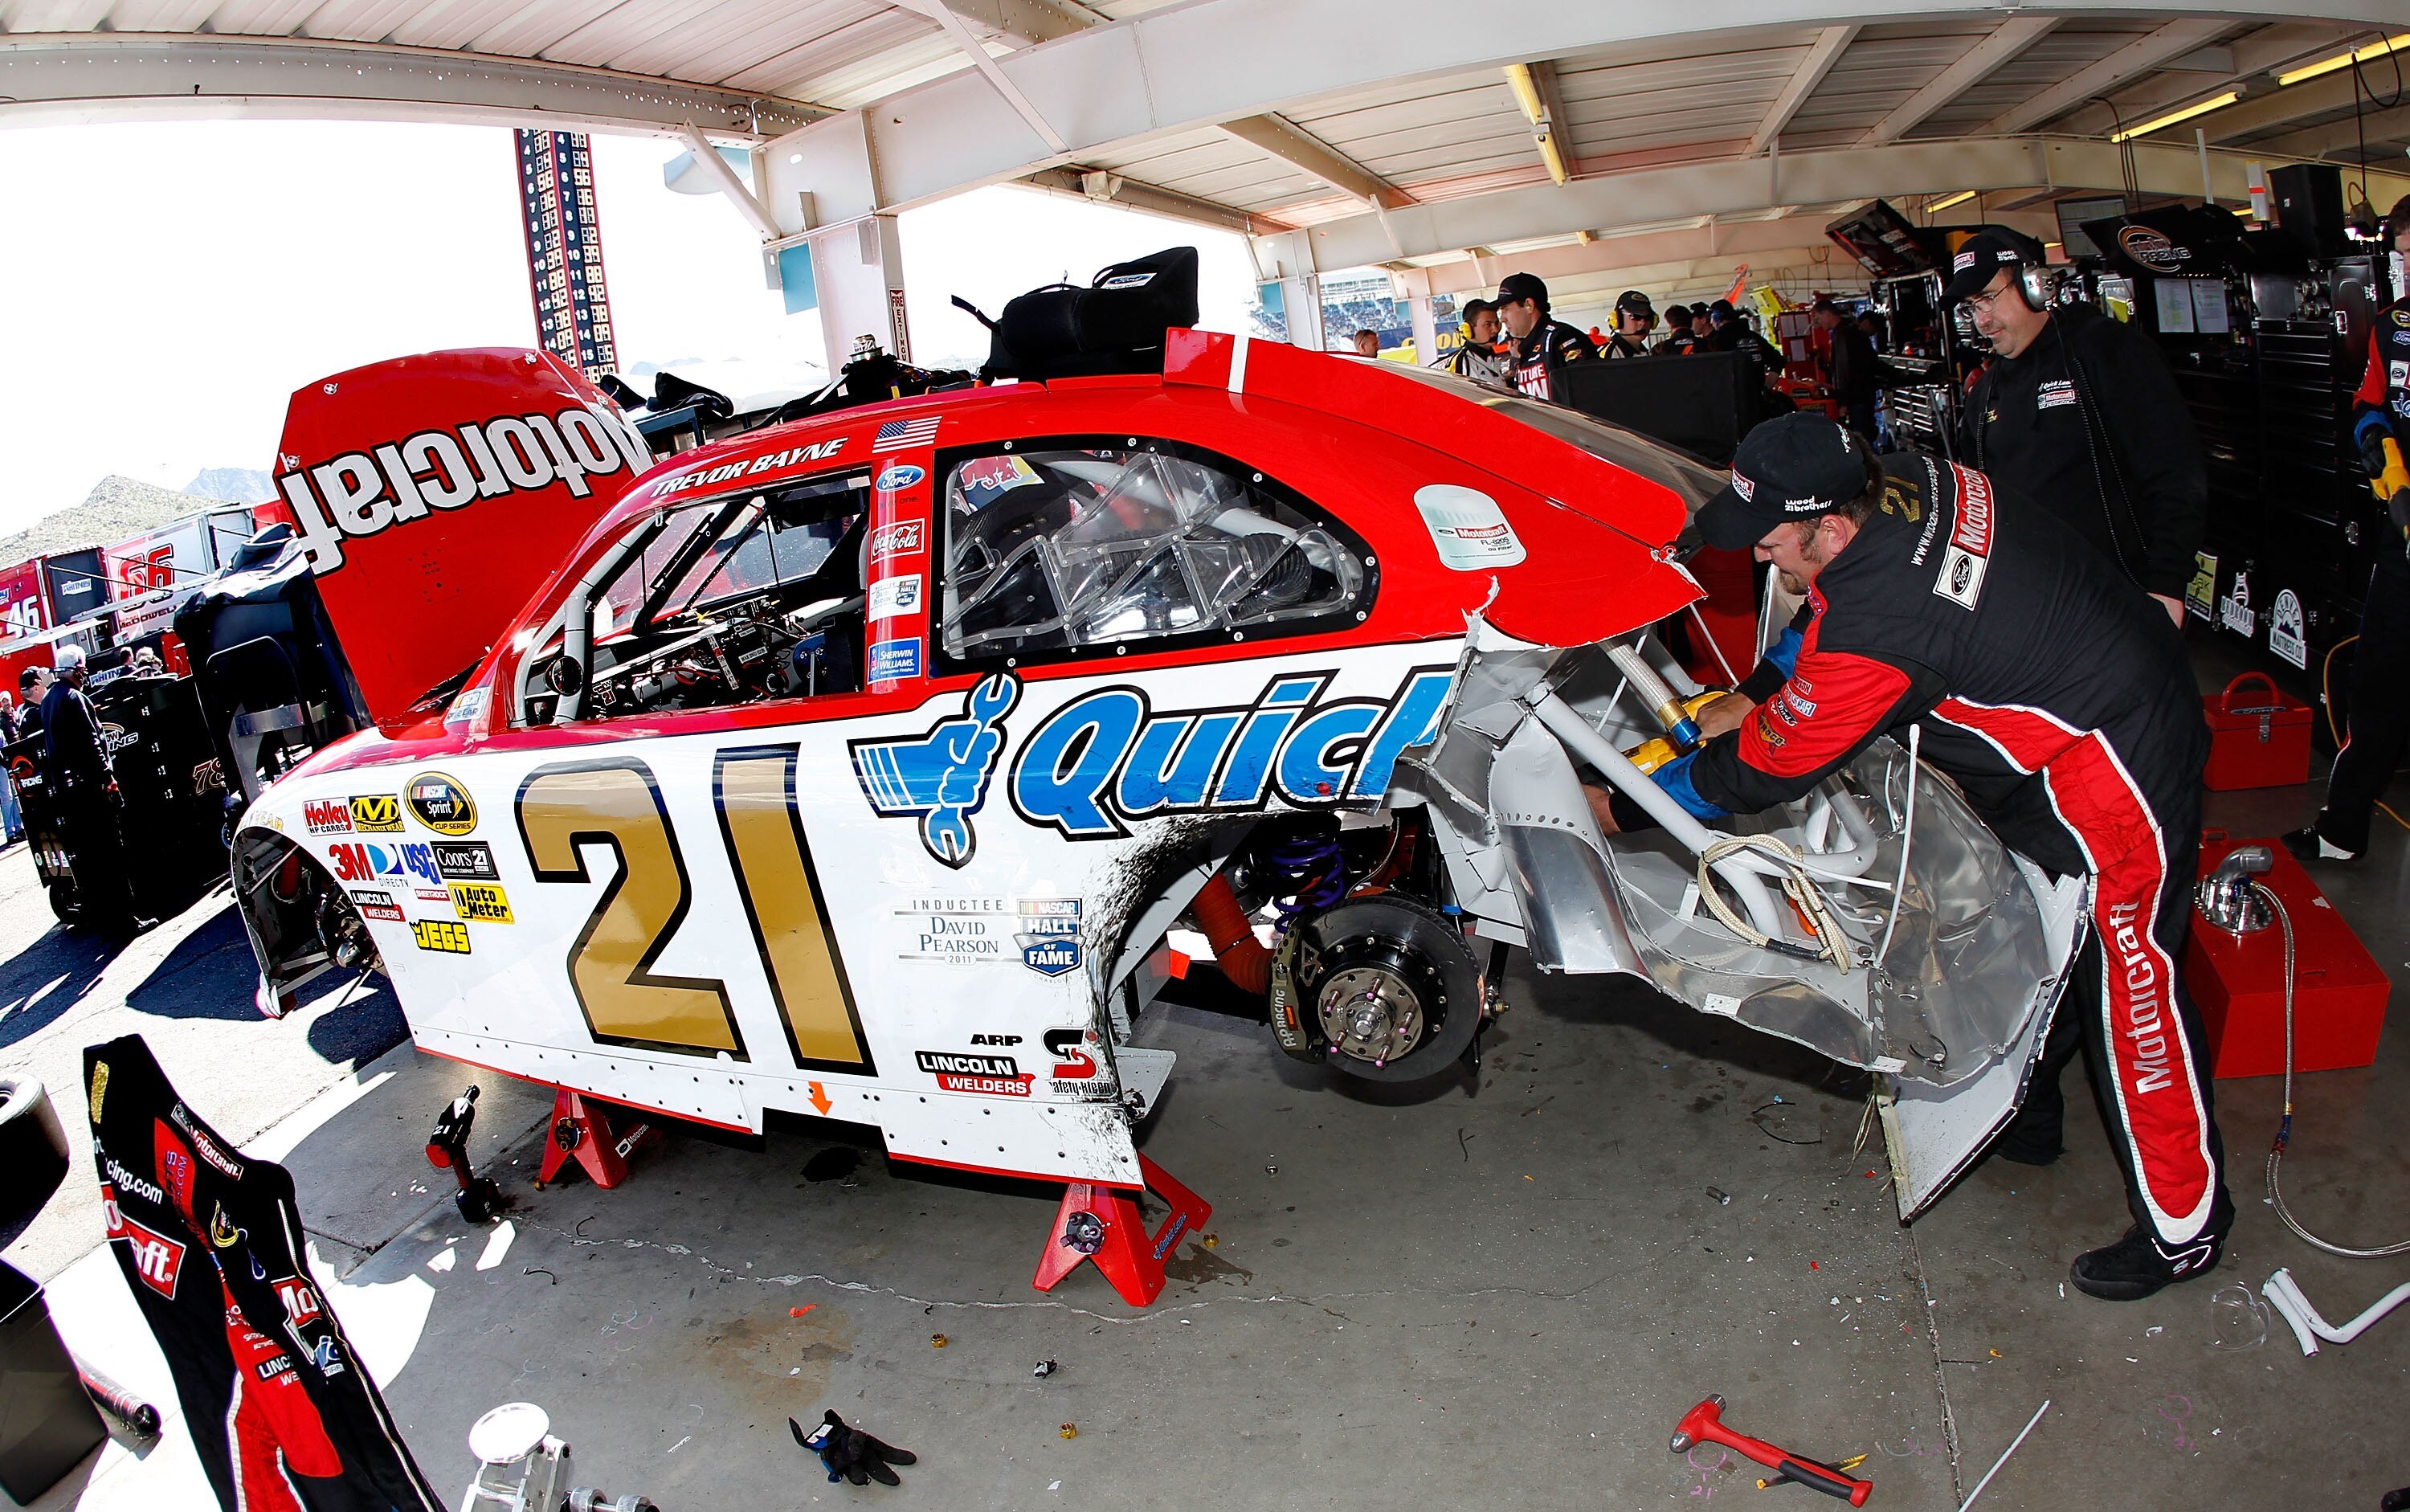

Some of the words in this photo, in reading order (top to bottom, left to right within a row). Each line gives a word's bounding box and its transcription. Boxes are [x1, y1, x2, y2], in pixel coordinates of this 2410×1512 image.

[558, 133, 565, 145] 4
[524, 145, 530, 156] 4
[559, 152, 567, 164] 5
[526, 163, 532, 175] 5
[561, 171, 569, 183] 6
[527, 182, 535, 194] 6
[563, 190, 570, 202] 7
[529, 202, 536, 214] 7
[565, 210, 573, 222] 8
[531, 221, 539, 232] 8
[567, 230, 575, 241] 9
[533, 241, 541, 252] 9
[567, 249, 581, 261] 10
[534, 259, 546, 272] 10
[570, 269, 582, 280] 11
[537, 279, 547, 292] 11
[573, 289, 586, 300] 12
[539, 298, 551, 312] 12
[575, 309, 589, 321] 13
[541, 318, 553, 331] 13
[578, 329, 591, 341] 14
[545, 337, 557, 351] 14
[581, 349, 594, 362] 15
[649, 460, 750, 498] TREVOR
[749, 437, 849, 475] BAYNE
[882, 468, 914, 489] Ford
[279, 407, 657, 577] Motorcraft
[1785, 495, 1816, 505] wood
[1880, 476, 1921, 523] 21
[1795, 500, 1832, 513] brothers
[1956, 464, 1987, 552] Motorcraft
[1456, 525, 1507, 538] Motorcraft
[120, 543, 175, 613] 66
[1955, 562, 1971, 588] Ford
[898, 596, 913, 604] FAME
[6, 595, 40, 638] 46
[880, 648, 914, 660] SHERWIN
[880, 658, 916, 669] WILLIAMS.
[108, 732, 139, 752] ING
[193, 757, 226, 796] 78
[423, 784, 447, 799] NASCAR
[427, 799, 452, 818] Sprint
[304, 800, 353, 832] Holley
[321, 824, 346, 833] CARBS
[354, 822, 386, 832] MECHANIX
[386, 820, 405, 832] WEAR
[449, 822, 472, 830] SERIES
[435, 847, 472, 867] Coors
[472, 849, 488, 866] 21
[329, 843, 375, 881] 3M
[400, 843, 443, 885] USG
[351, 892, 393, 906] LINCOLN
[415, 890, 448, 900] SHEETROCK
[465, 887, 496, 902] Auto
[468, 901, 508, 918] Meter
[514, 742, 880, 1078] 21
[913, 899, 1003, 911] INDUCTEE
[1037, 901, 1077, 914] NASCAR
[366, 907, 401, 920] WELDERS
[929, 916, 986, 936] DAVID
[1027, 917, 1074, 934] HALL
[416, 919, 472, 954] JEGS
[919, 934, 999, 954] PEARSON
[1043, 943, 1057, 951] OF
[949, 954, 972, 964] 2011
[1028, 950, 1075, 966] FAME
[2107, 900, 2172, 1096] Motorcraft
[970, 1033, 1023, 1047] ARP
[919, 1053, 1014, 1077] LINCOLN
[946, 1076, 1027, 1096] WELDERS
[432, 1125, 451, 1134] 21
[1158, 1230, 1175, 1253] Quick
